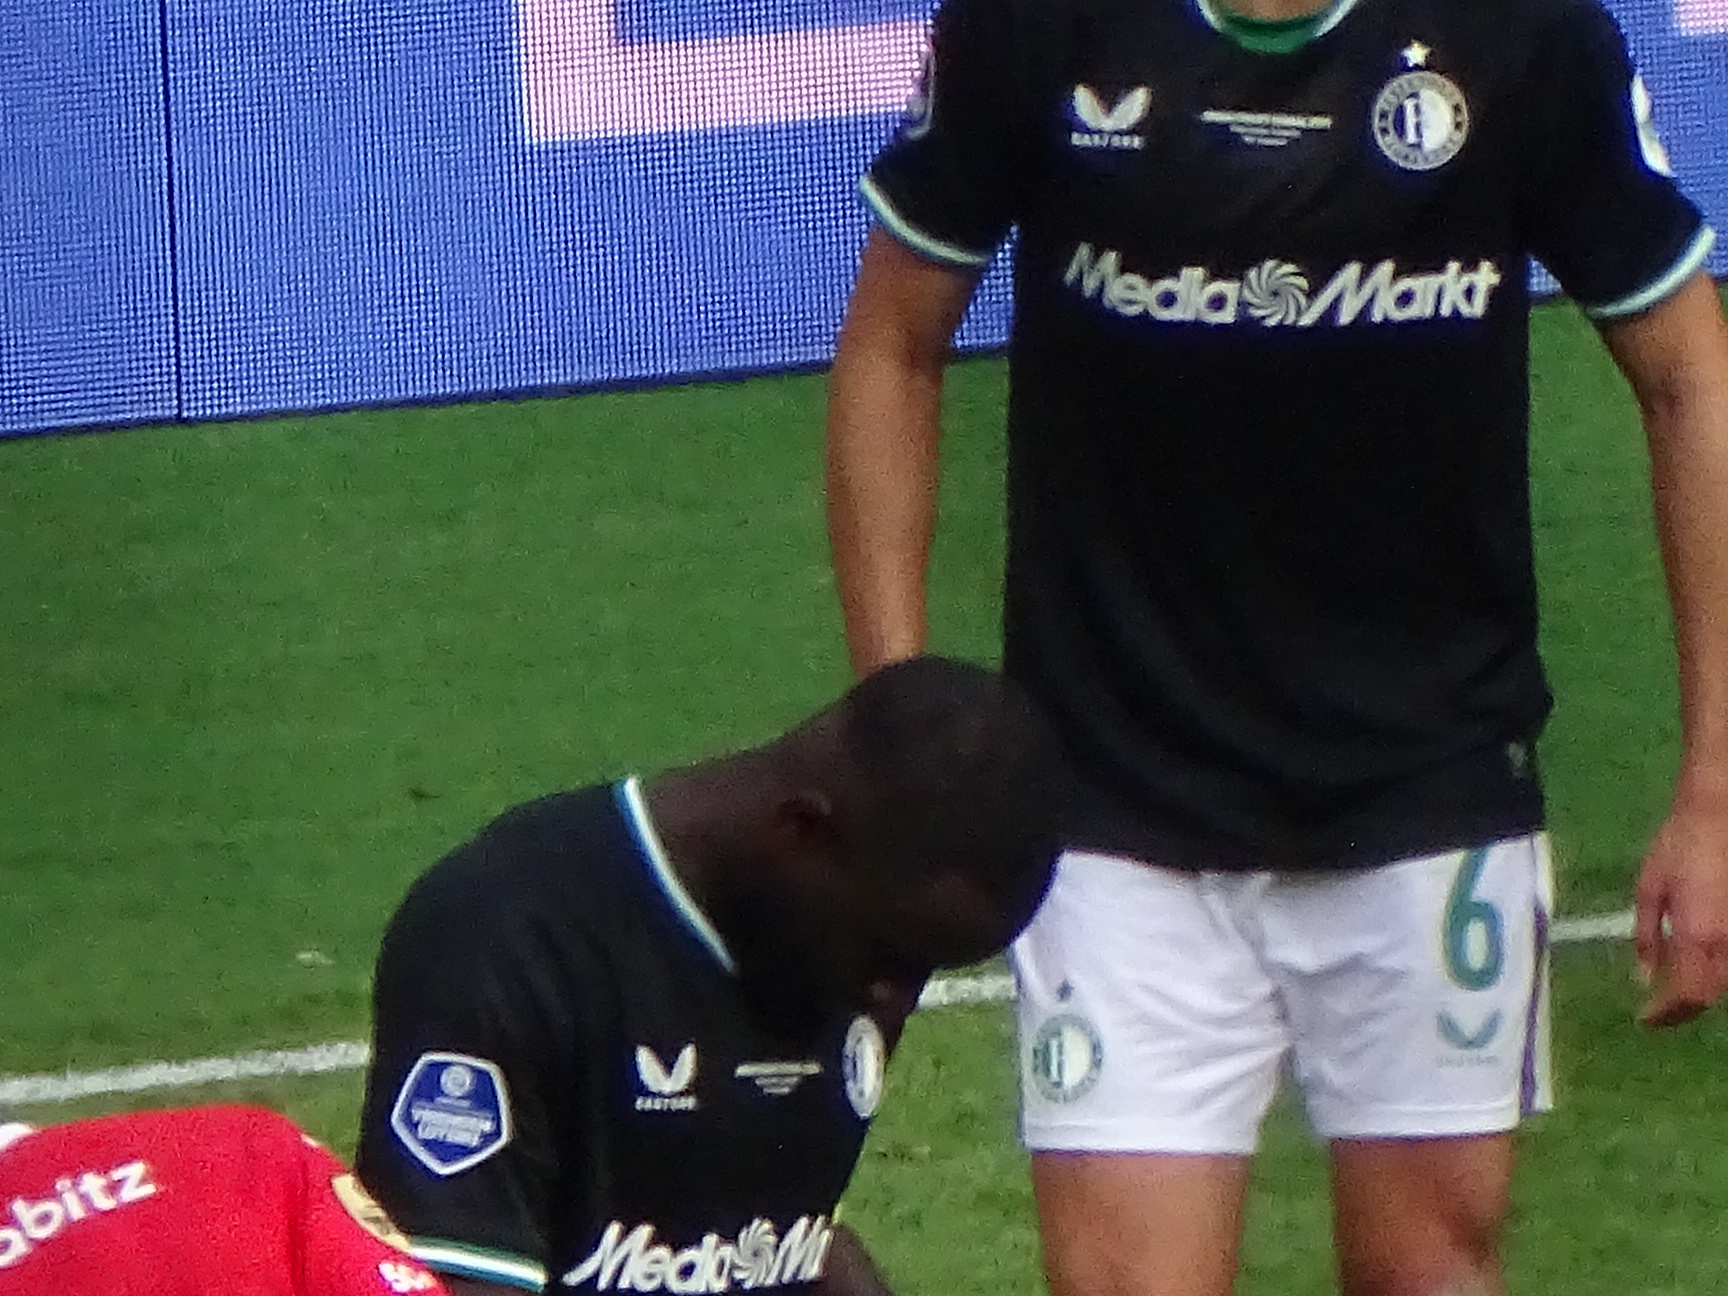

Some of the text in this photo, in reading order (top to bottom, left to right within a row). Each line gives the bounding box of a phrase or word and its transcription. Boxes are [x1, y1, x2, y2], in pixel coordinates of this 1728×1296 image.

[1065, 241, 1502, 328] Media Markt
[1442, 845, 1506, 992] 6
